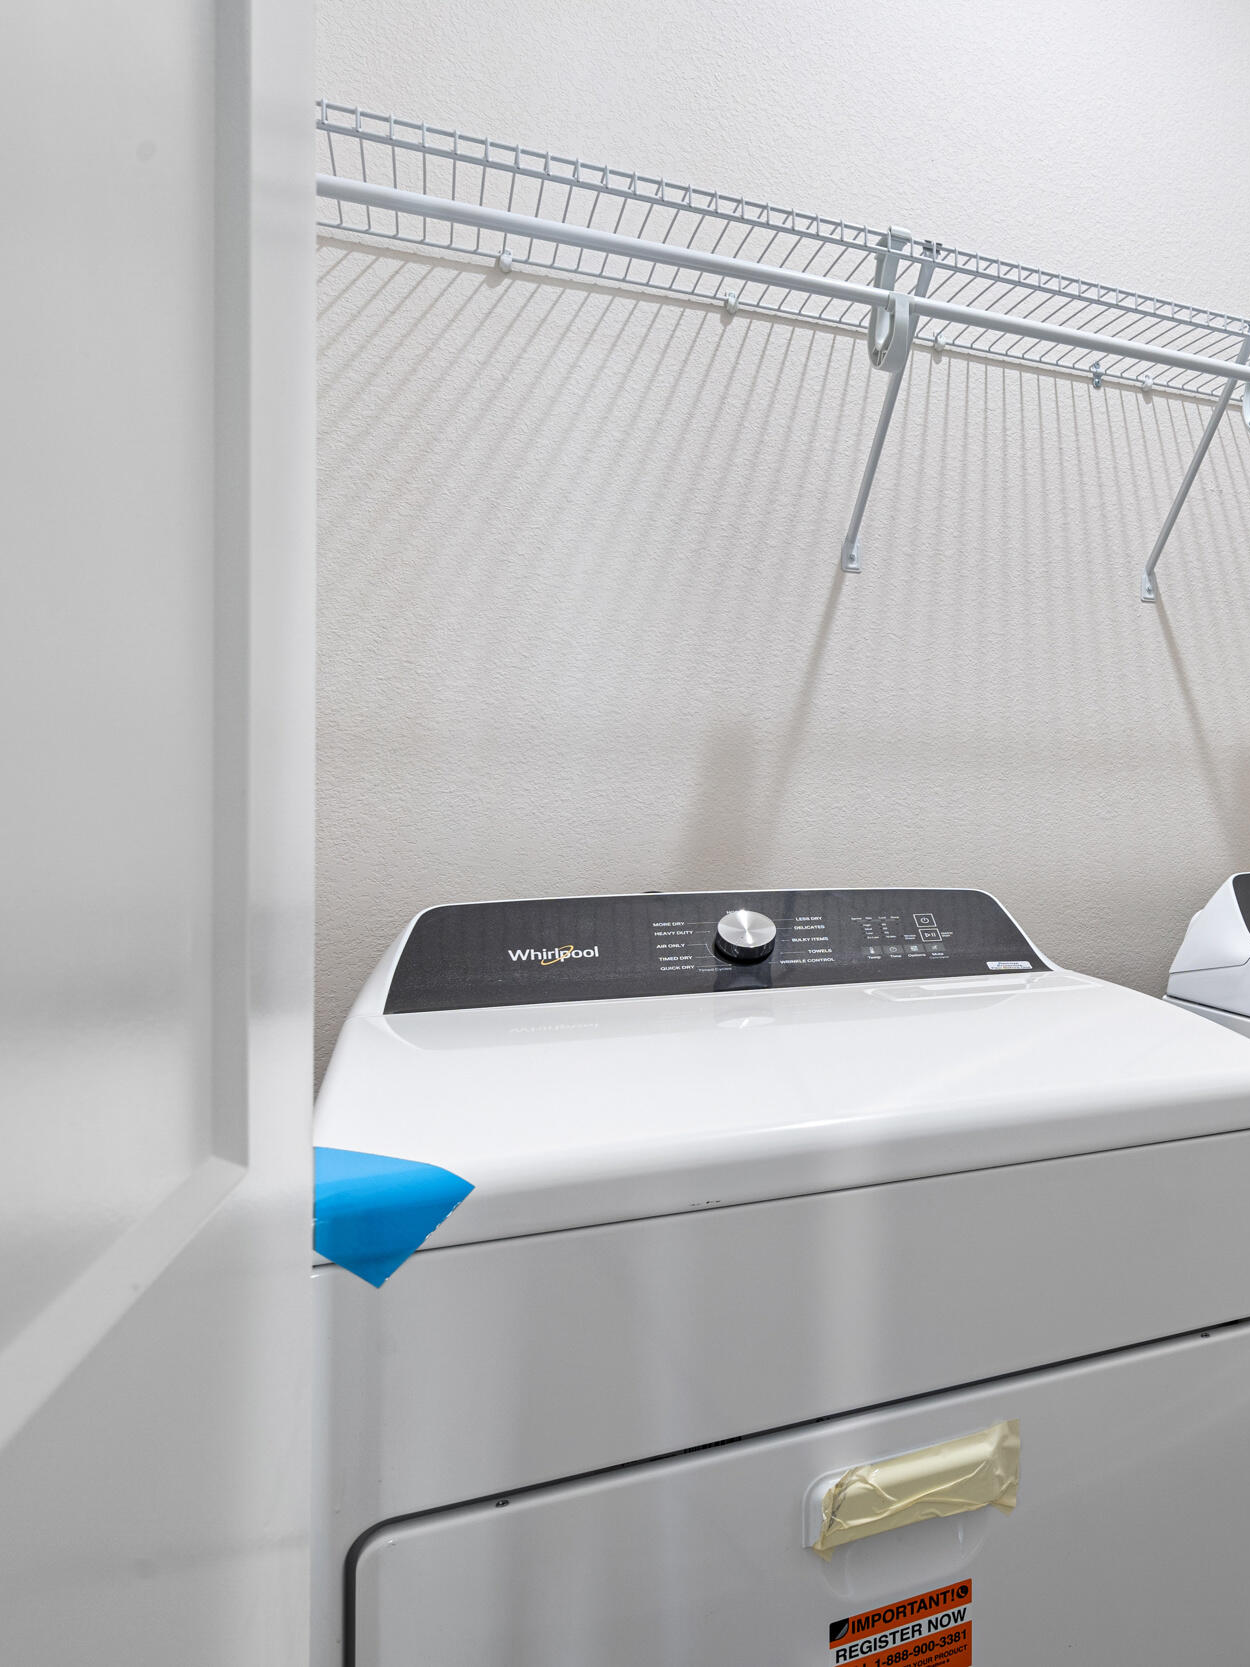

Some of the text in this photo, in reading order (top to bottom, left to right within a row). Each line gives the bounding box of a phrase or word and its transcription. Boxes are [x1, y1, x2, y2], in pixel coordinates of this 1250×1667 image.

[508, 946, 599, 963] Whirlpool
[851, 1589, 955, 1634] IMPORTANT!
[836, 1608, 967, 1664] REGISTER NOW
[875, 1629, 967, 1667] 1-888-900-3381
[912, 1656, 932, 1667] YOUR
[935, 1644, 967, 1661] PRODUCT
